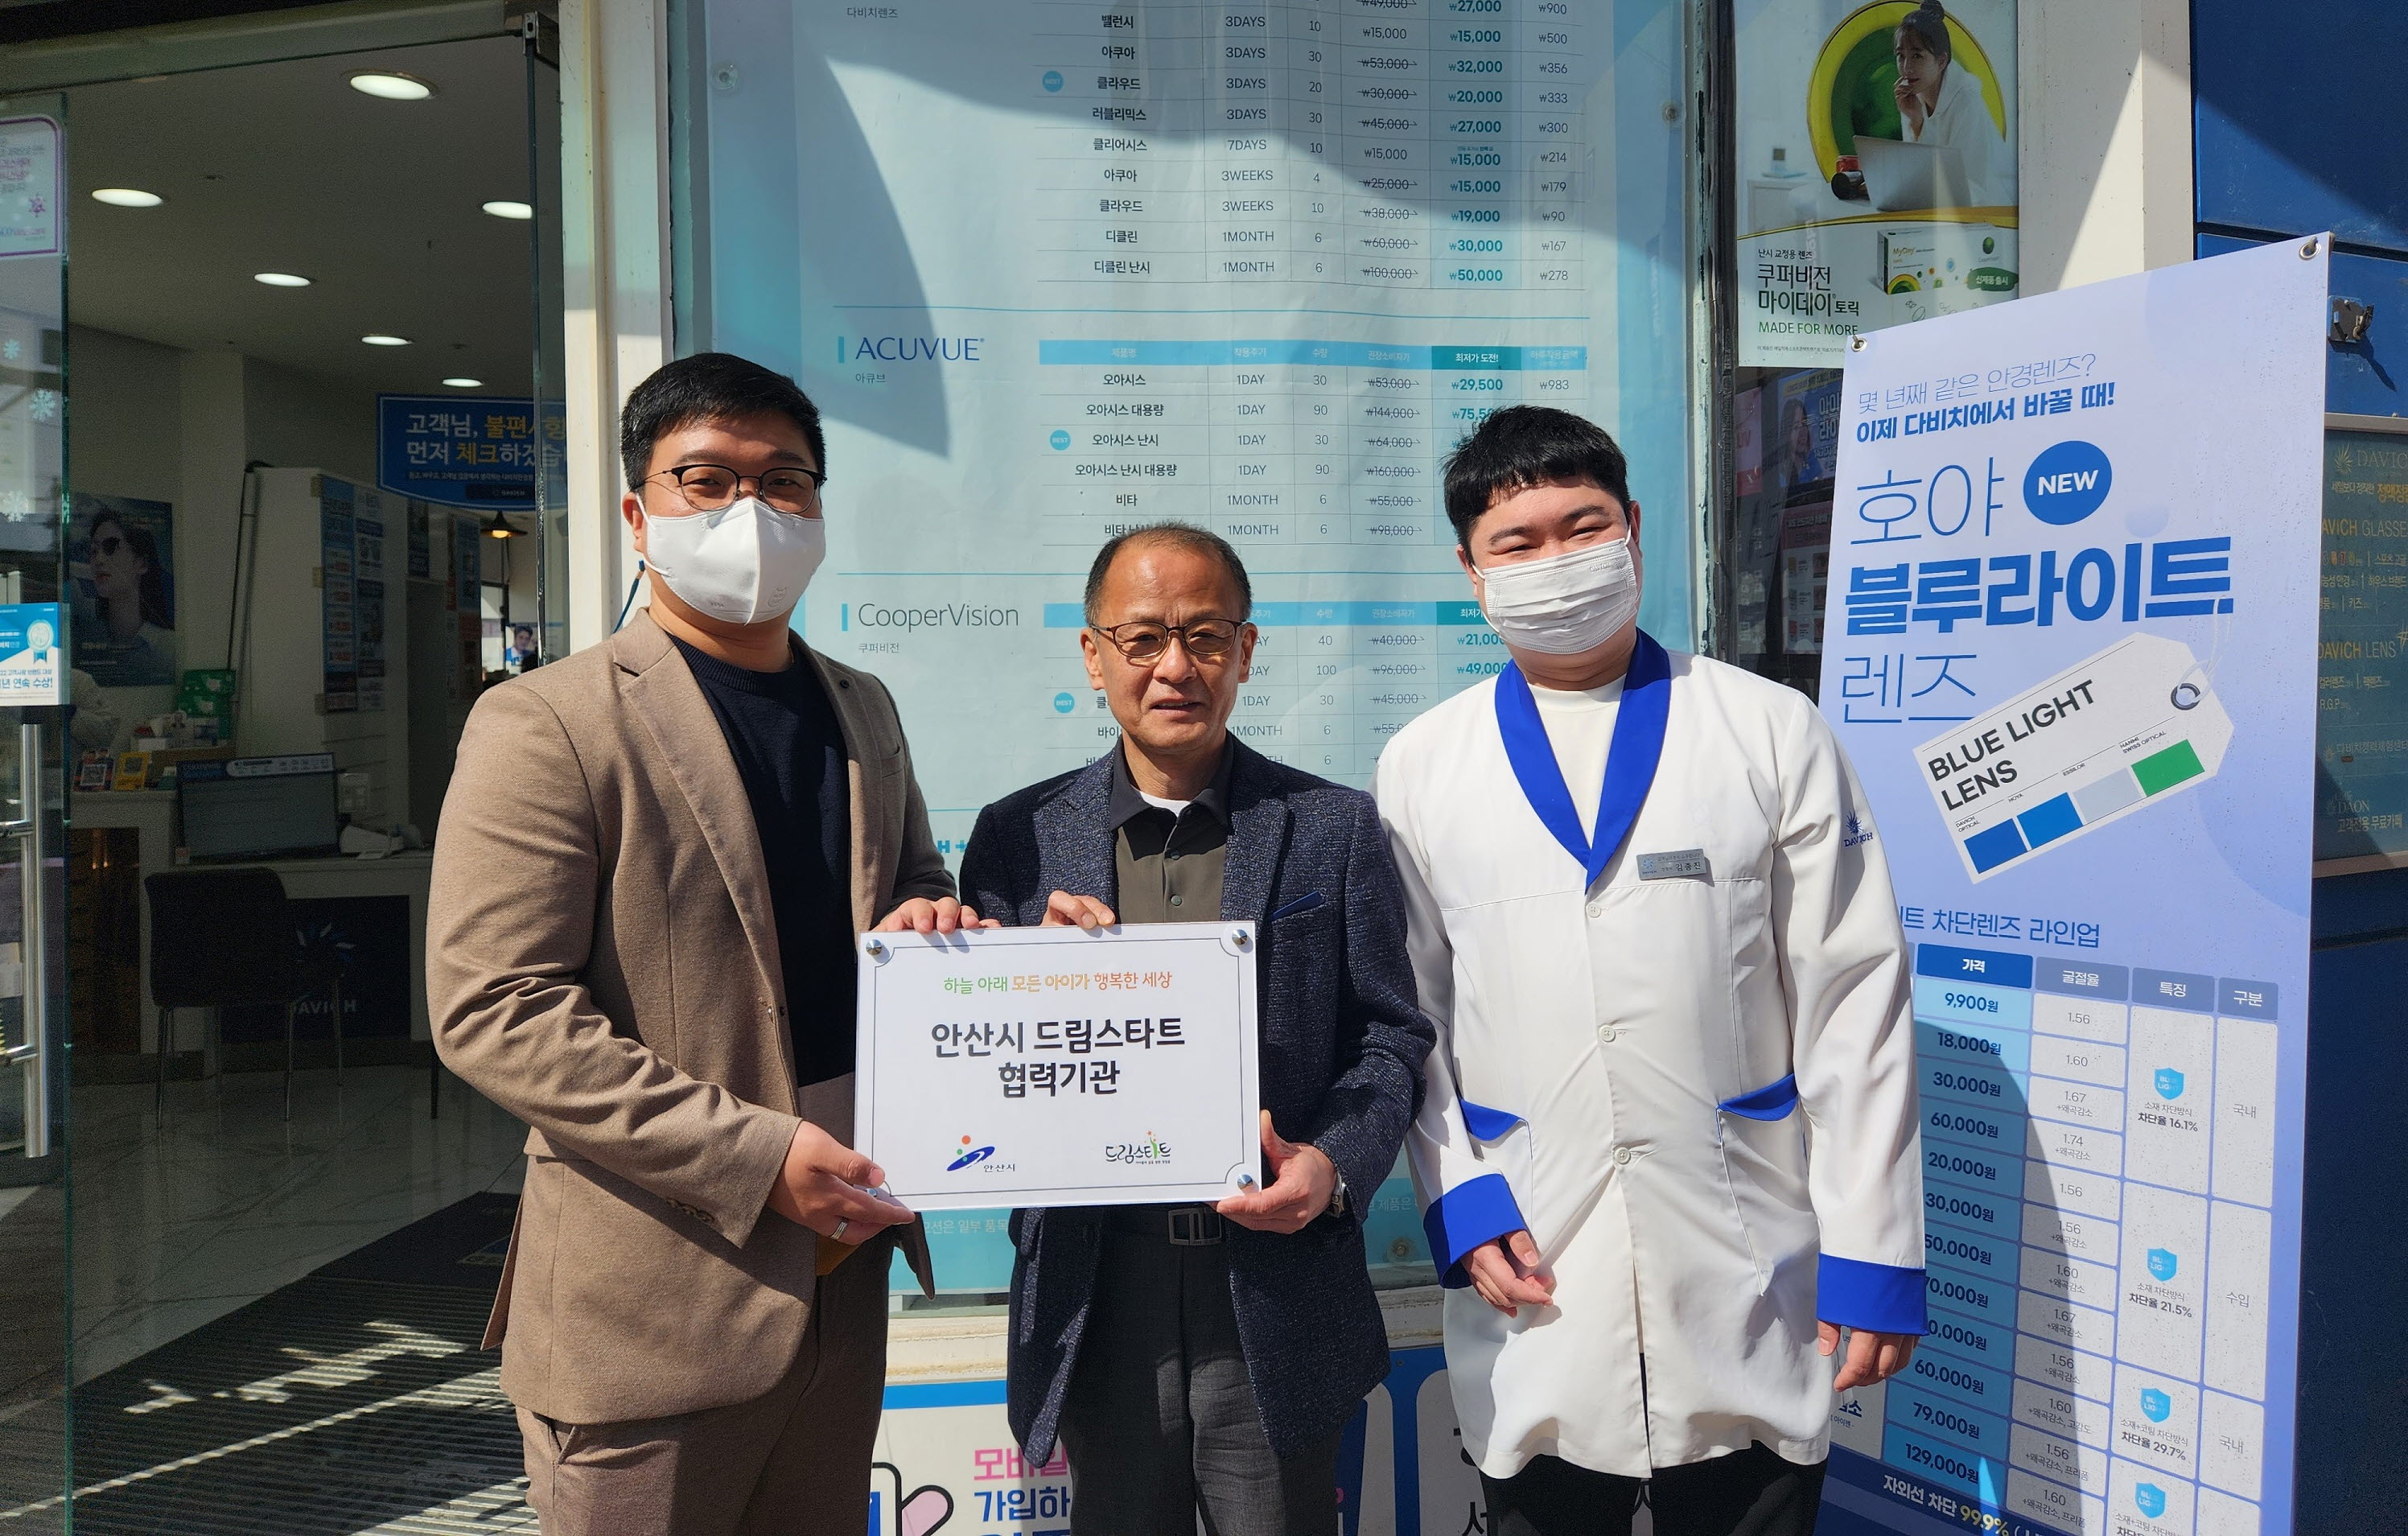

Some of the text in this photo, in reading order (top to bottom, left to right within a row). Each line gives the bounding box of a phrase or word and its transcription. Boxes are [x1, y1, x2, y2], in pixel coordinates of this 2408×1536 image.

[846, 7, 899, 19] 다비치렌즈
[1101, 14, 1134, 29] 밸런시
[1225, 16, 1266, 27] 3DAYS
[1101, 46, 1135, 60] 아쿠아
[1225, 47, 1266, 59] 3DAYS
[1308, 51, 1322, 62] 30
[1097, 76, 1141, 91] 클라우드
[1226, 78, 1266, 89] 3DAYS
[1309, 82, 1322, 93] 20
[1092, 107, 1146, 121] 러블리믹스
[1226, 109, 1266, 120] 3DAYS
[1309, 113, 1322, 123] 30
[1093, 138, 1147, 152] 클리어시스
[1228, 139, 1266, 150] 7DAYS
[1103, 169, 1138, 183] 아쿠아
[1221, 170, 1273, 181] 3WEEKS
[1099, 200, 1143, 212] 클라우드
[1222, 200, 1274, 212] 3WEEKS
[1311, 203, 1323, 214] 10
[1105, 230, 1138, 243] 디클린
[1223, 231, 1274, 242] 1MONTH
[1758, 249, 1813, 259] 난시 교정용 렌즈
[1094, 261, 1150, 274] 디클린 난시
[1223, 261, 1274, 273] 1MONTH
[1758, 264, 1830, 291] 쿠퍼비전
[1976, 275, 2008, 285] 신제품 출시
[1758, 290, 1859, 317] 마이데이 토릭
[1759, 322, 1794, 334] MADE
[1797, 323, 1821, 335] FOR
[1455, 352, 1499, 363] 최저가 도전!
[855, 373, 886, 383] 아큐브
[1103, 374, 1146, 386] 오아시스
[1237, 374, 1266, 385] 1DAY
[1313, 375, 1327, 385] 30
[1859, 353, 2096, 414] 몇 년째 같은 안경렌즈?
[1086, 404, 1164, 417] 오아시스 대용량
[1237, 405, 1266, 415] 1DAY
[1314, 405, 1327, 415] 90
[1856, 417, 1897, 443] 이제
[1904, 397, 2015, 435] 다비치에서
[2023, 389, 2073, 418] 바꿀
[2081, 382, 2115, 410] 때!
[406, 413, 478, 439] 고객님,
[1093, 434, 1159, 447] 오아시스 난시
[1238, 434, 1266, 445] 1DAY
[1315, 434, 1328, 445] 30
[406, 441, 448, 465] 먼저
[1076, 464, 1177, 477] 오아시스 난시 대용량
[1238, 465, 1266, 476] 1DAY
[1315, 464, 1329, 475] 90
[2037, 469, 2099, 496] NEW
[1116, 494, 1137, 506] 비타
[1227, 495, 1278, 505] 1MONTH
[1850, 456, 2005, 545] 호야
[1228, 525, 1278, 535] 1MONTH
[1845, 536, 2233, 636] 블루라이트
[858, 603, 1019, 632] CooperVision
[1318, 636, 1332, 645] 40
[858, 643, 899, 653] 쿠퍼비전
[2366, 641, 2396, 658] LENS
[1316, 665, 1336, 675] 100
[14, 677, 52, 689] 연속 수상!
[1842, 653, 1977, 723] 렌즈
[1243, 696, 1270, 706] 1DAY
[1928, 678, 2094, 781] BLUE LIGHT
[2140, 731, 2167, 747] OPTICAL
[1941, 760, 2018, 811] LENS
[2338, 801, 2369, 813] DAON
[1955, 816, 1976, 828] DAVICH
[1958, 820, 1981, 834] OPTICAL
[2338, 814, 2402, 832] 고객전용 무료카페
[1844, 832, 1873, 847] DAVICH
[1933, 908, 2021, 941] 차단렌즈
[2030, 918, 2100, 949] 라인업
[1962, 958, 1986, 974] 가격
[944, 971, 1171, 994] 하늘 아래 모든 아이가 행복한 세상
[2062, 970, 2100, 987] 굴절율
[2159, 982, 2187, 998] 특징
[1945, 992, 1998, 1013] 9,900원
[2233, 990, 2263, 1007] 구분
[2068, 1012, 2090, 1025] 1.56
[932, 1018, 1185, 1058] 안산시 드림스타트
[1937, 1032, 2002, 1056] 18,000원
[2065, 1055, 2088, 1067] 1.60
[998, 1060, 1121, 1097] 협력기관
[1933, 1072, 2001, 1097] 30,000원
[2064, 1090, 2086, 1103] 1.67
[2233, 1103, 2256, 1118] 국내
[1931, 1112, 1998, 1139] 60,000원
[2138, 1112, 2198, 1131] 차단율 16.1%
[2063, 1134, 2084, 1146] 1.74
[1105, 1138, 1171, 1163] 드림스타트
[983, 1163, 1015, 1173] 안산시
[1928, 1152, 1996, 1180] 20,000원
[2060, 1184, 2083, 1197] 1.56
[1925, 1192, 1994, 1223] 30,000원
[958, 1219, 979, 1233] 일부
[2057, 1221, 2081, 1235] 1.56
[2056, 1264, 2079, 1279] 1.60
[2130, 1292, 2192, 1317] 차단율 21.5%
[2226, 1292, 2249, 1307] 수입
[2054, 1308, 2076, 1324] 1.67
[2051, 1353, 2074, 1369] 1.56
[1915, 1359, 1985, 1396] 60,000원
[2048, 1398, 2072, 1414] 1.60
[1912, 1402, 1980, 1440] 79,000원
[2046, 1443, 2069, 1460] 1.56
[2122, 1431, 2186, 1460] 차단율 29.7%
[2219, 1435, 2243, 1454] 국내
[1905, 1443, 1978, 1485] 129,000원
[2043, 1489, 2066, 1505] 1.60
[974, 1487, 1070, 1522] 가입하
[1883, 1474, 2009, 1536] 자외선 차단 99.9%
